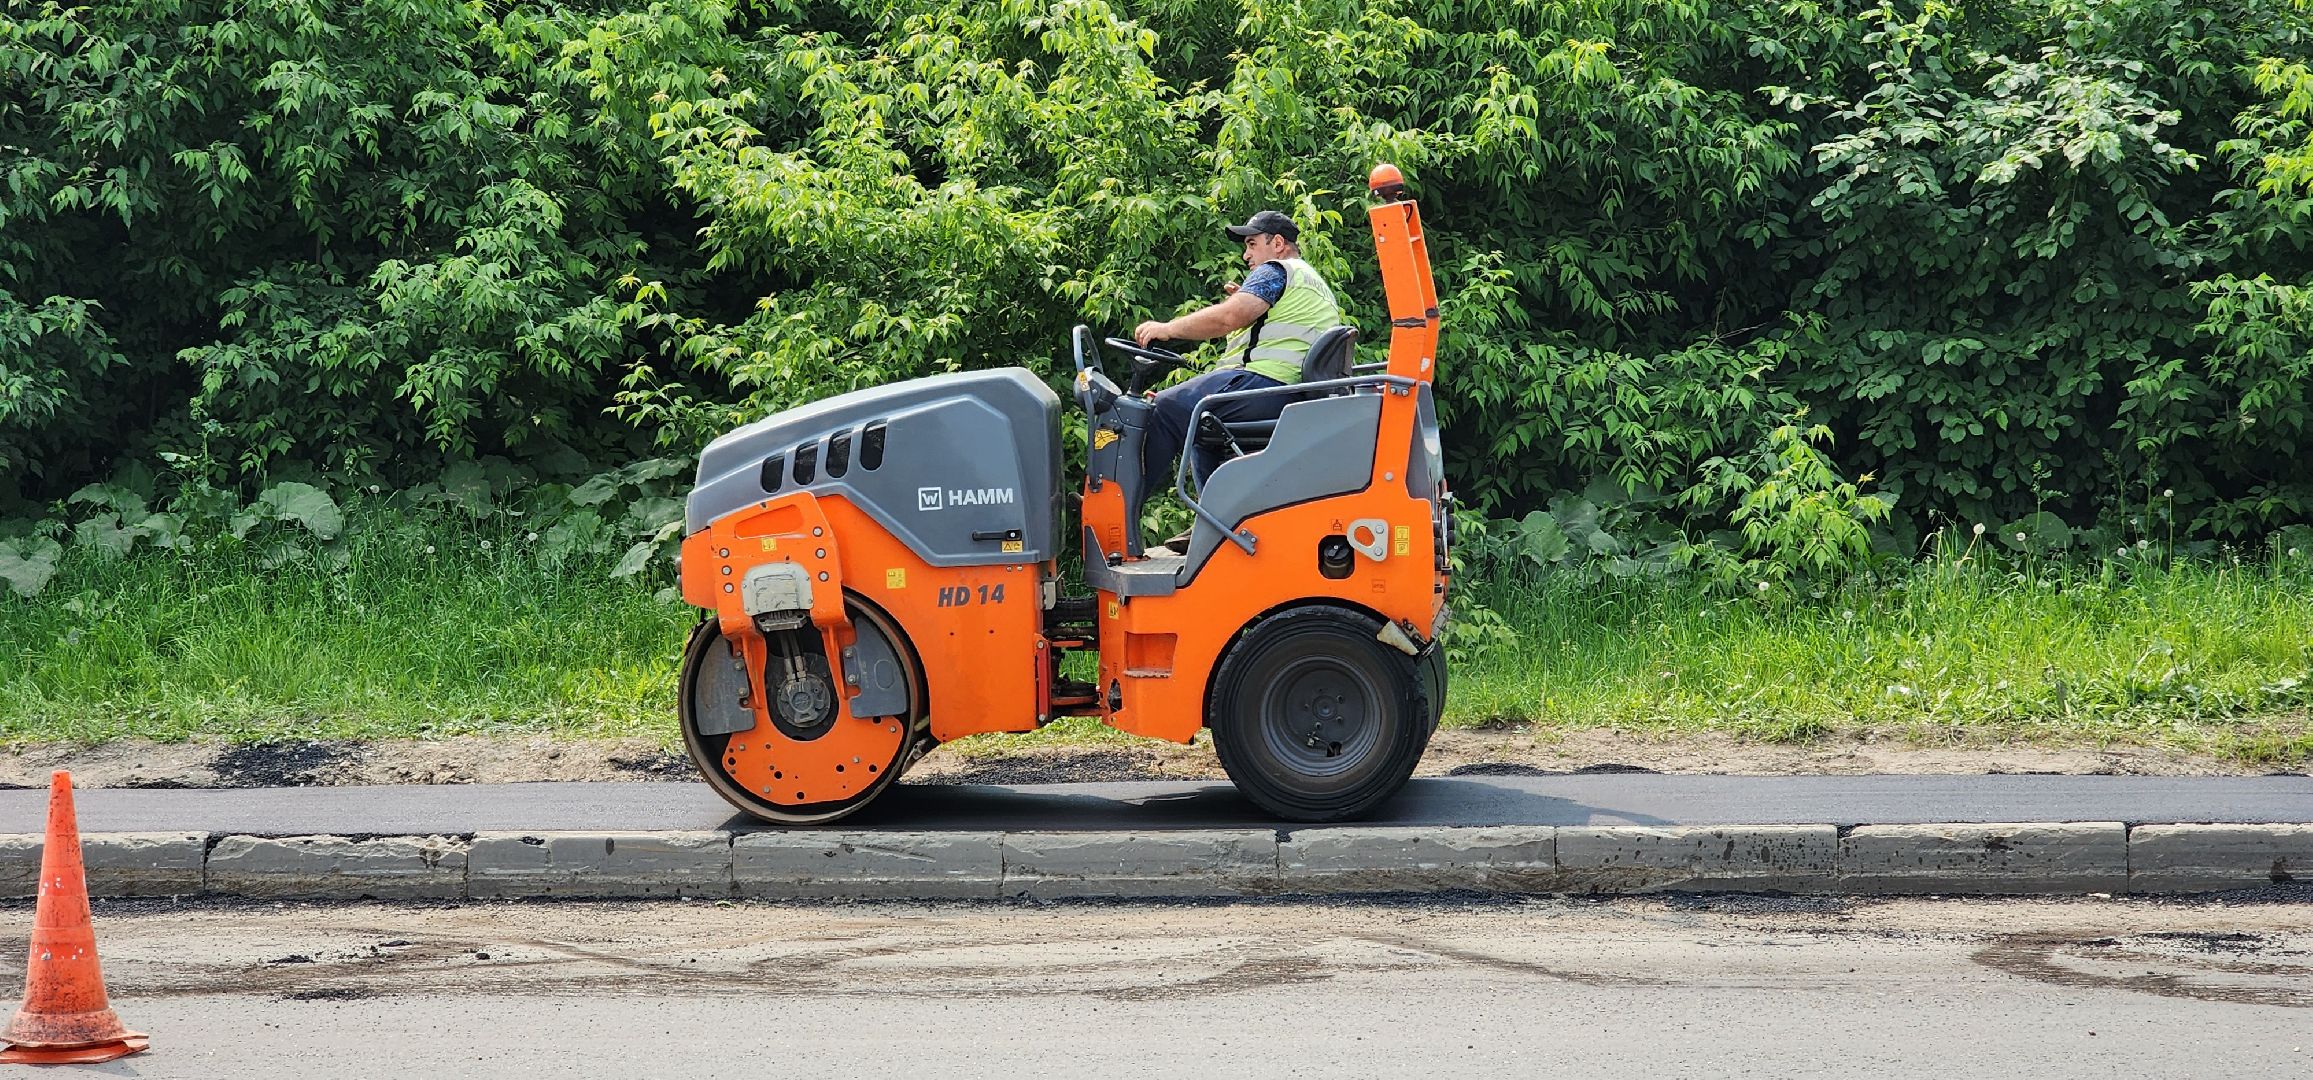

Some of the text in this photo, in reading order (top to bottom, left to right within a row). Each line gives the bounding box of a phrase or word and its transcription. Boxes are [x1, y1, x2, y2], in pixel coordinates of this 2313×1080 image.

[948, 487, 1014, 506] HAMM
[938, 584, 1005, 608] HD 14
